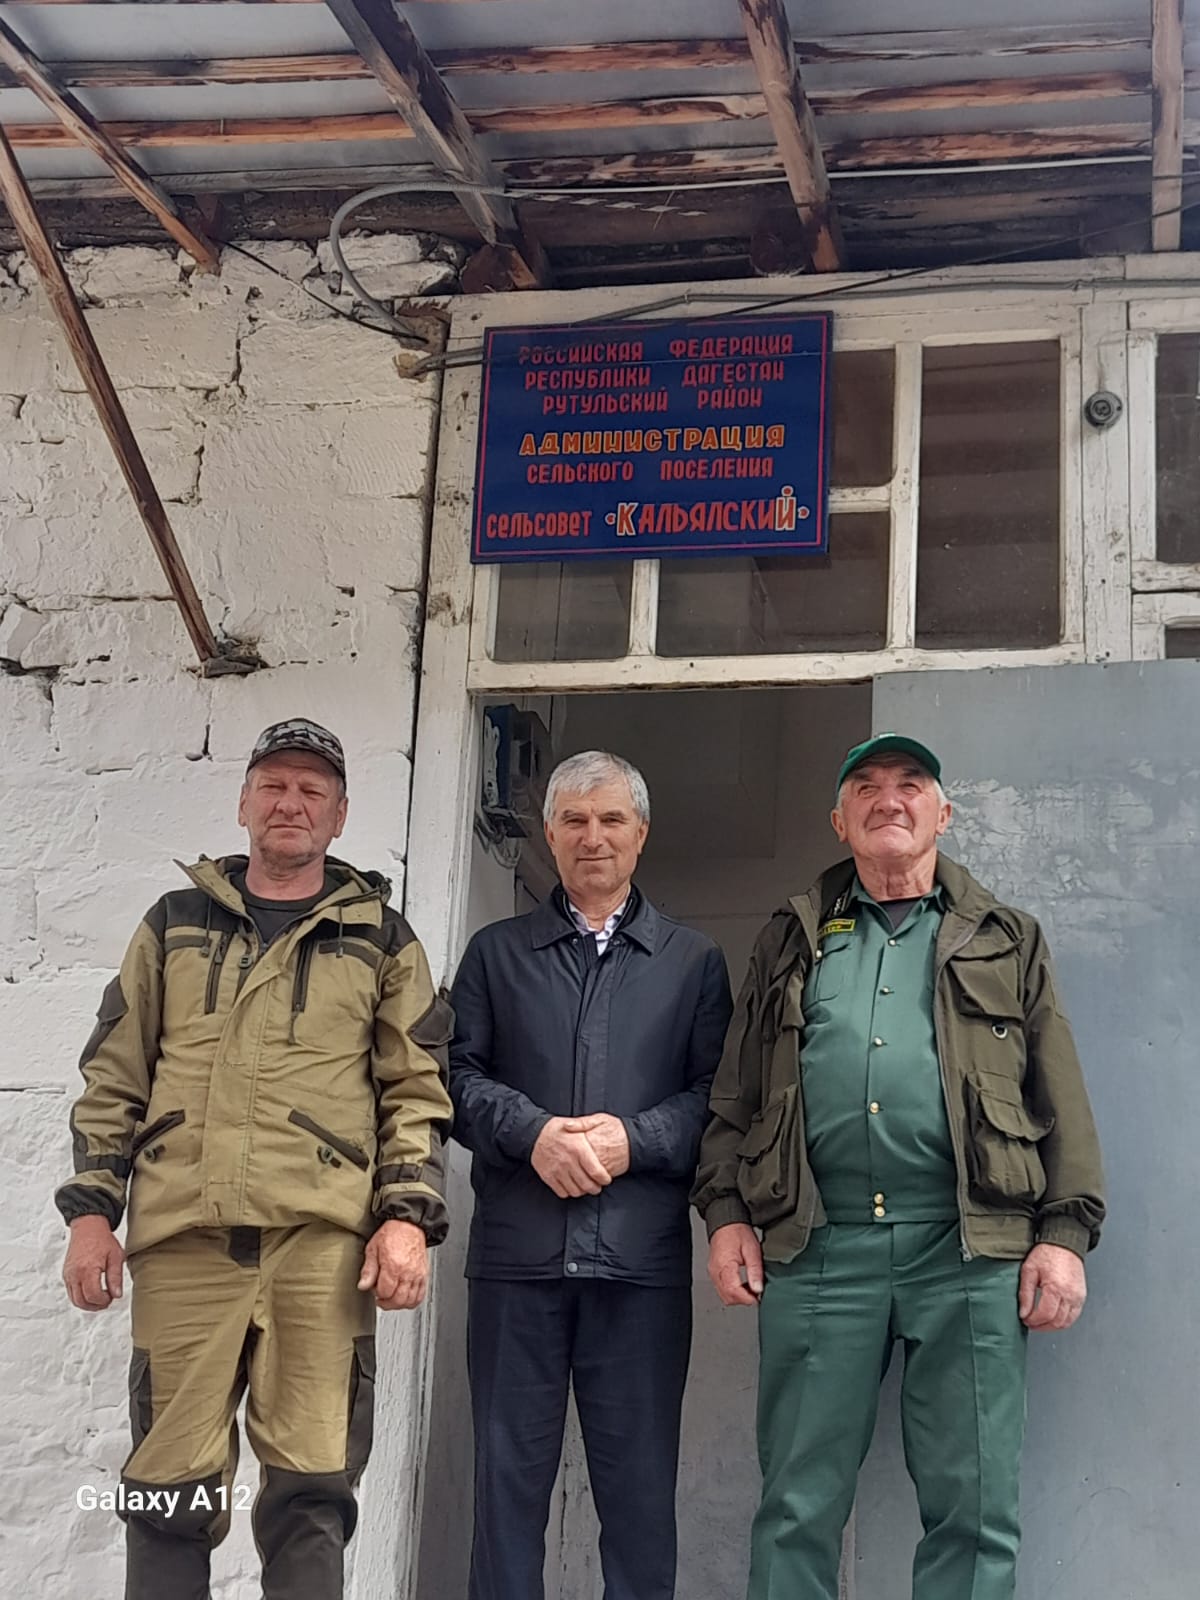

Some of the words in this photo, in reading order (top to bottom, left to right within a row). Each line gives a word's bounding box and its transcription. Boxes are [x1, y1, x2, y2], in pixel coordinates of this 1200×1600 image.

[669, 334, 793, 359] ФЕДЕРАЦИЯ
[525, 366, 651, 390] РЕСПУБЛИКИ
[682, 360, 784, 387] ДАГЕСТАН
[542, 386, 668, 415] РУТУЛЬСКИЙ
[697, 384, 763, 410] РАЙОН
[519, 425, 785, 456] АДМИНИСТРАЦИЯ
[527, 460, 634, 484] СЕЛЬСКОГО
[660, 457, 774, 481] ПОСЕЛЕНИЯ
